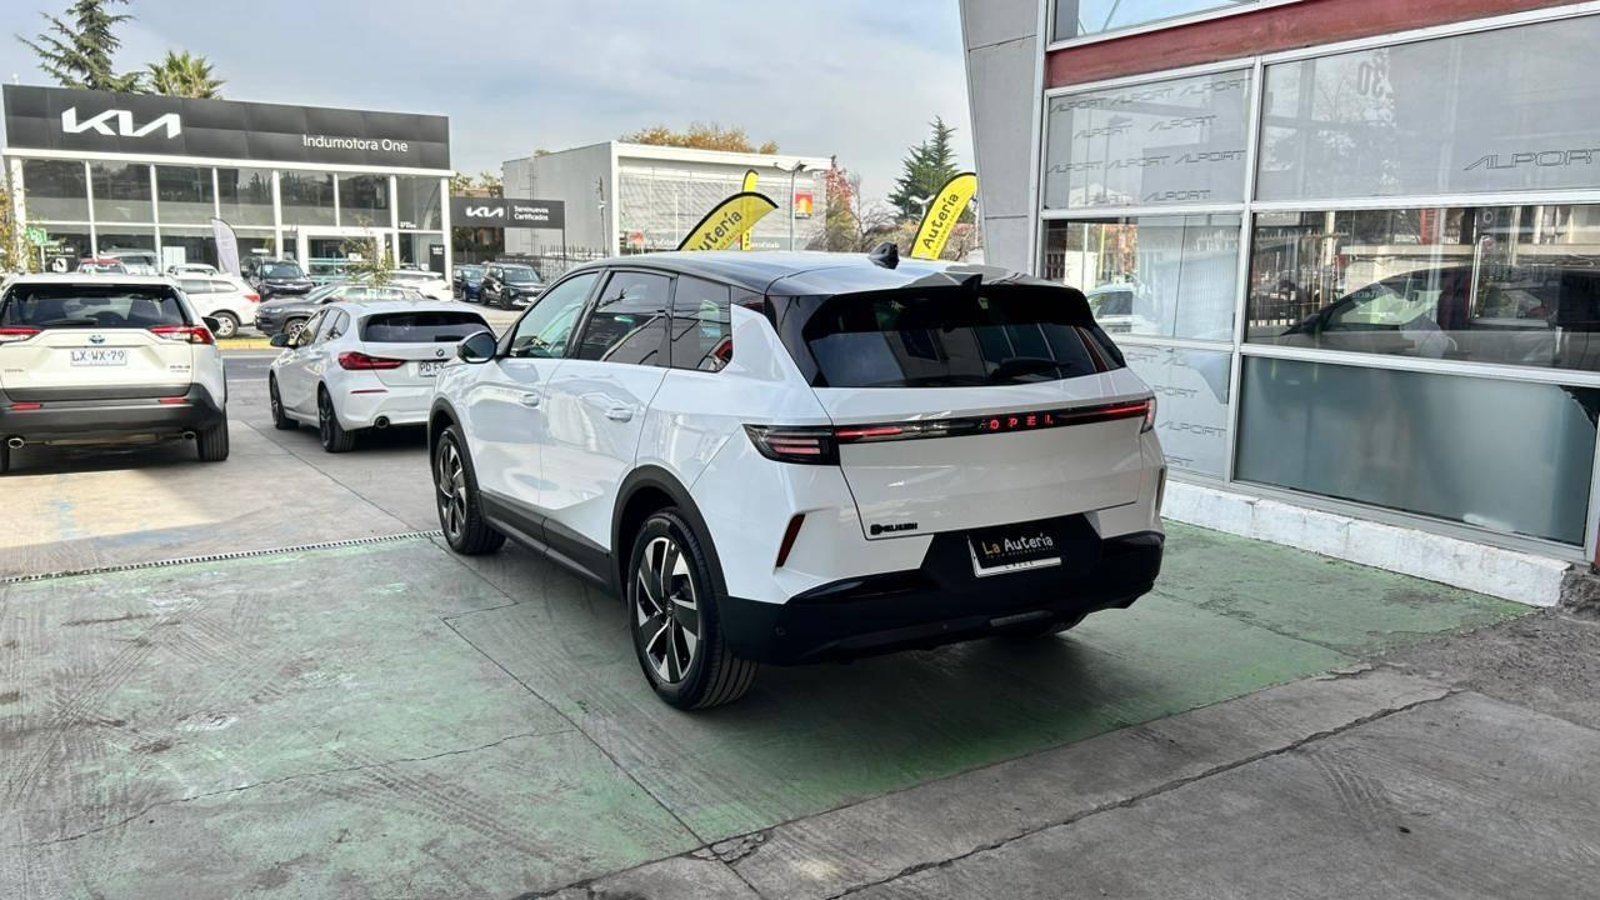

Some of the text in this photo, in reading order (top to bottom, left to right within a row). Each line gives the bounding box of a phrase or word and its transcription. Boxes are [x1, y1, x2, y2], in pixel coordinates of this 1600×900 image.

[1050, 97, 1107, 113] ALPORT
[1111, 88, 1173, 106] ALPORT
[61, 106, 181, 139] KIA
[1149, 115, 1217, 132] ALPORT
[302, 134, 408, 152] Indumotora One
[1107, 156, 1170, 170] ALPORT
[1175, 150, 1246, 165] ALPORT
[1143, 190, 1211, 202] ALPORT
[466, 206, 504, 218] KIA
[922, 193, 960, 250] Autería
[691, 211, 743, 250] utería
[990, 414, 1055, 430] OPEL
[1159, 420, 1227, 437] ALPORT
[982, 541, 1001, 555] La
[1004, 532, 1054, 552] Autería
